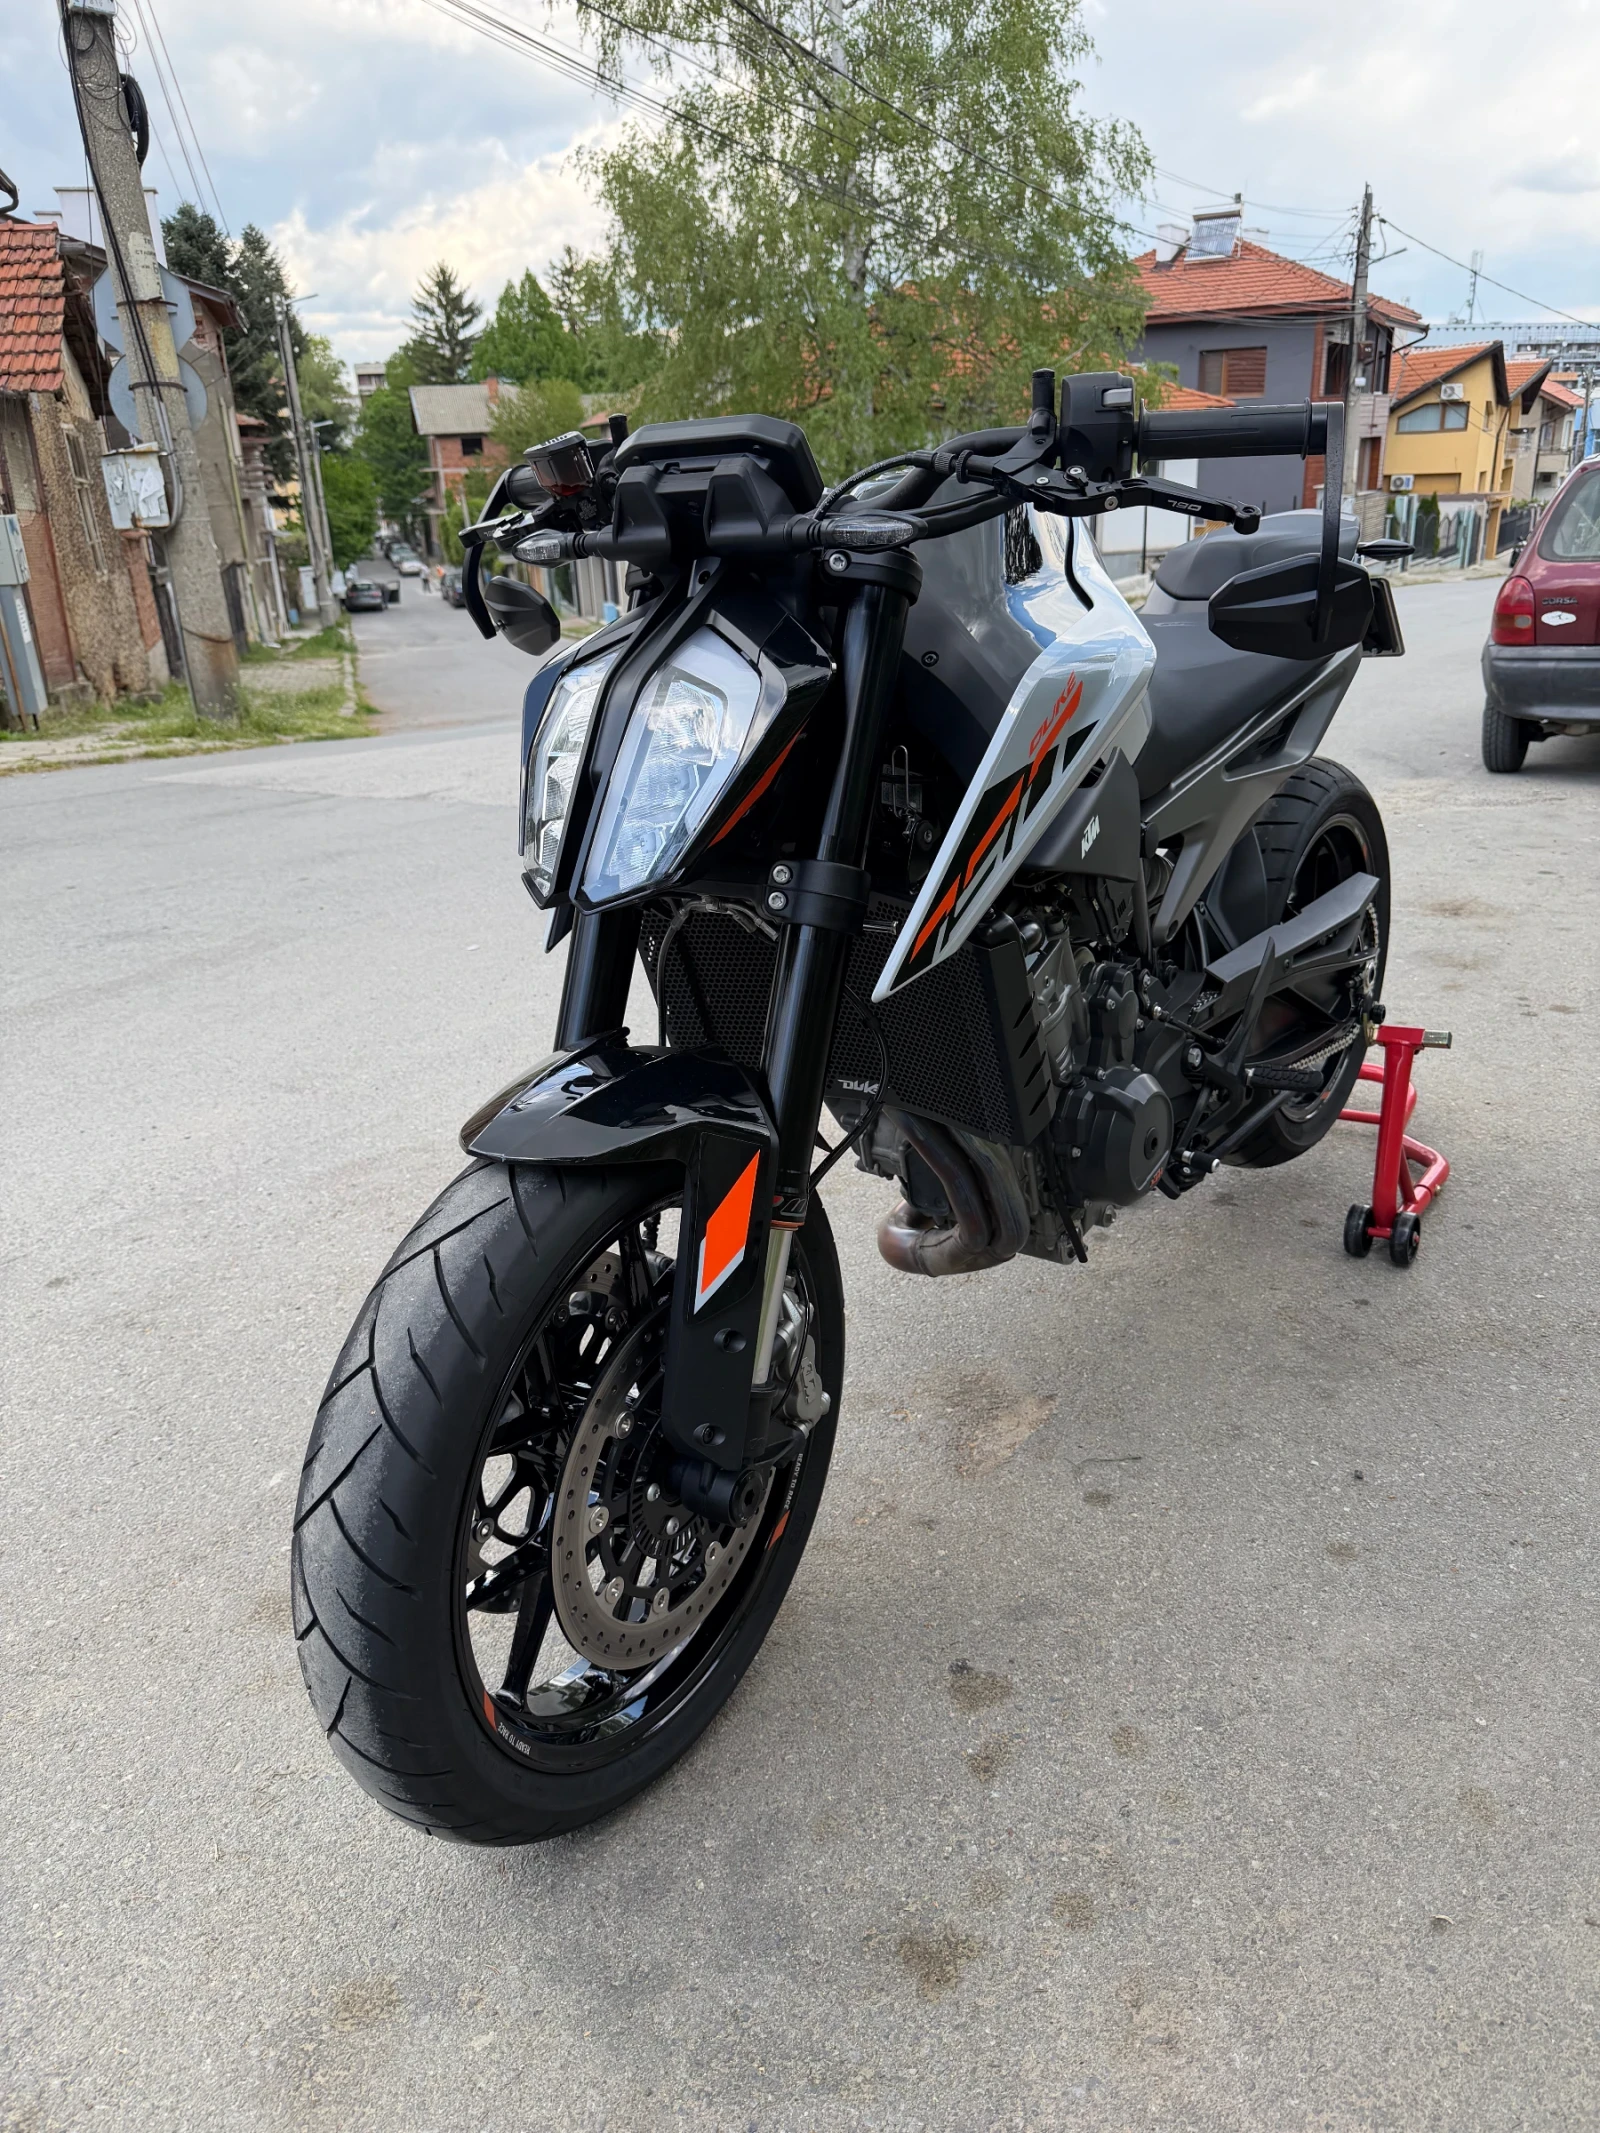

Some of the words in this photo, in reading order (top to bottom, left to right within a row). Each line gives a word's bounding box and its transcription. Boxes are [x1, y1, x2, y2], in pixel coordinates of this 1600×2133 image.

[1167, 499, 1202, 511] 790
[1542, 597, 1578, 605] CORSA
[1028, 669, 1076, 758] DUKE
[1081, 814, 1100, 860] KTM
[794, 1453, 804, 1477] READY
[790, 1478, 798, 1489] TO
[783, 1490, 794, 1510] RACE
[497, 1722, 510, 1740] RACE
[508, 1734, 516, 1746] TO
[515, 1740, 531, 1756] READY
